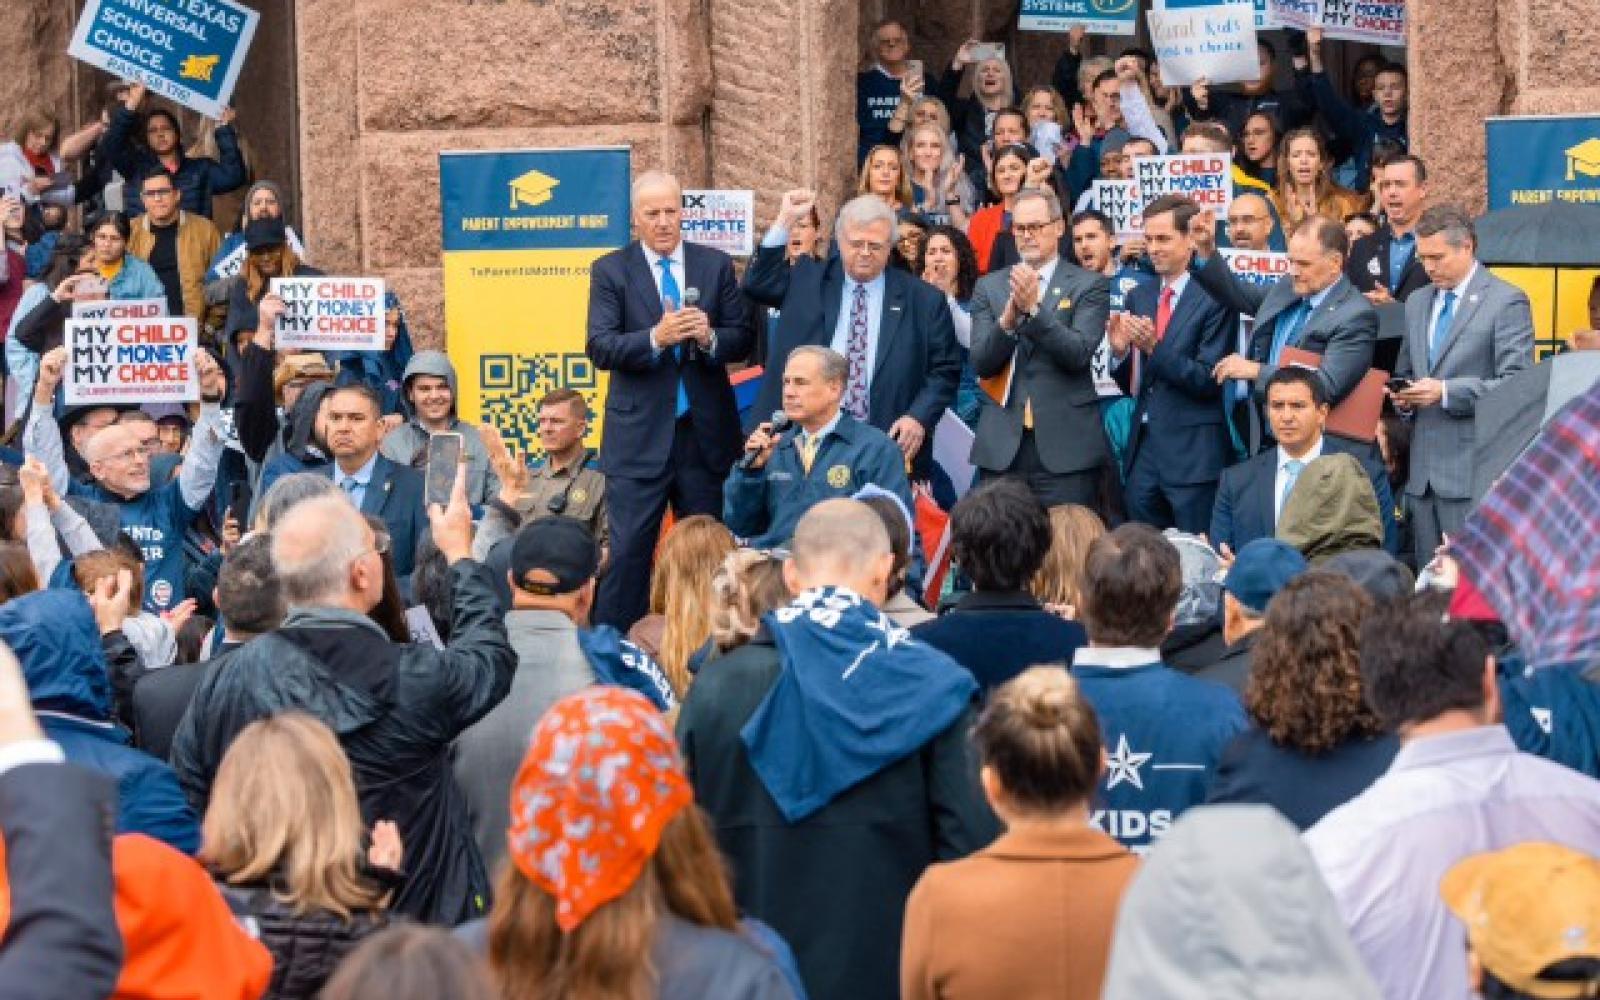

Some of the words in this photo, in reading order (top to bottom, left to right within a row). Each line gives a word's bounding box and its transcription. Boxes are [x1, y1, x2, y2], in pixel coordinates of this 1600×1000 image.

[102, 7, 174, 51] SCHOOL
[1139, 161, 1165, 175] MY
[1169, 159, 1223, 176] CHILD
[1099, 185, 1126, 199] MY
[1139, 177, 1165, 191] MY
[1170, 175, 1223, 190] MONEY
[1234, 255, 1288, 273] CHILD
[279, 283, 313, 298] MY
[317, 283, 376, 299] CHILD
[110, 304, 160, 318] CHILD
[282, 299, 313, 315] MY
[317, 300, 376, 316] MONEY
[72, 325, 113, 343] MY
[117, 324, 188, 344] CHILD
[279, 316, 313, 331] MY
[317, 316, 376, 334] CHOICE
[72, 344, 113, 363] MY
[117, 345, 188, 363] MONEY
[72, 364, 113, 383] MY
[117, 363, 189, 384] CHOICE
[1088, 809, 1172, 839] KIDS
